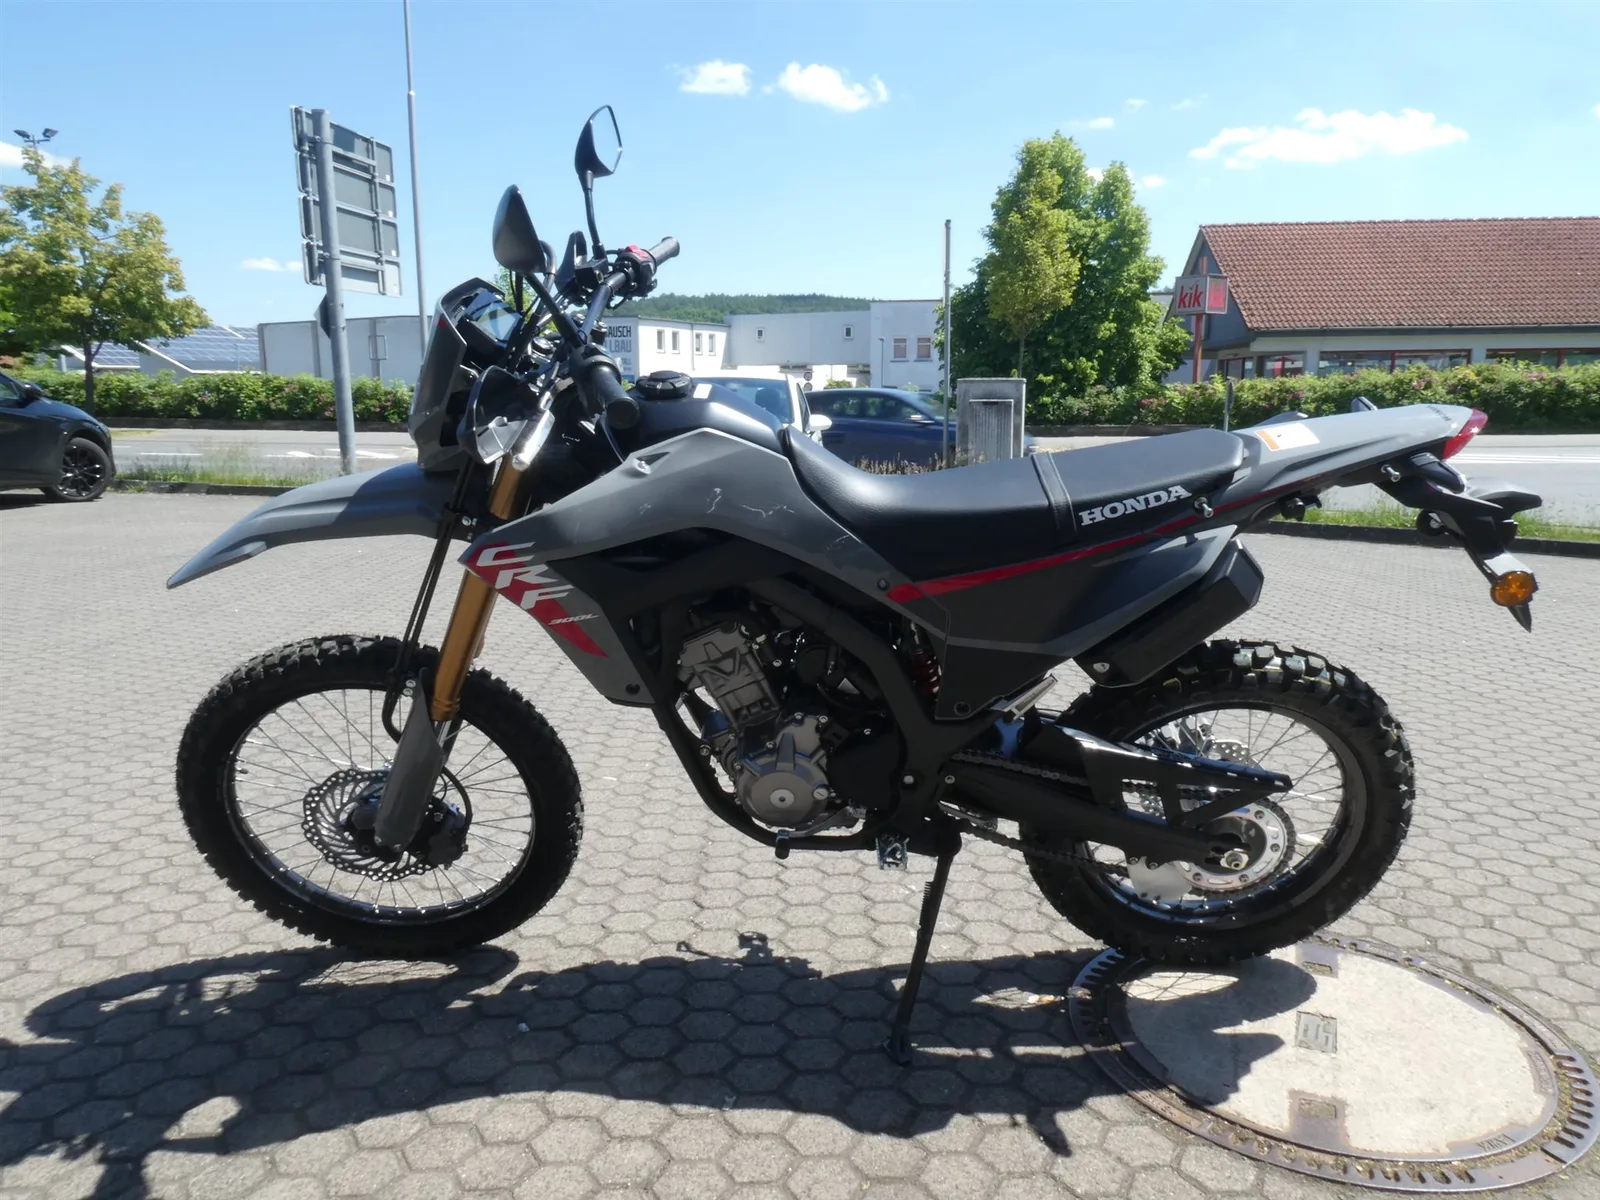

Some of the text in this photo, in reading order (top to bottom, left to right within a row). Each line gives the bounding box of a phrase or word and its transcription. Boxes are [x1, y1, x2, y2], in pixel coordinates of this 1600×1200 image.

[1178, 282, 1203, 308] kik
[606, 325, 632, 338] AUSCH
[603, 339, 632, 353] LBAU
[1079, 485, 1192, 526] HONDA
[476, 541, 575, 610] CRF
[548, 613, 599, 626] 300L
